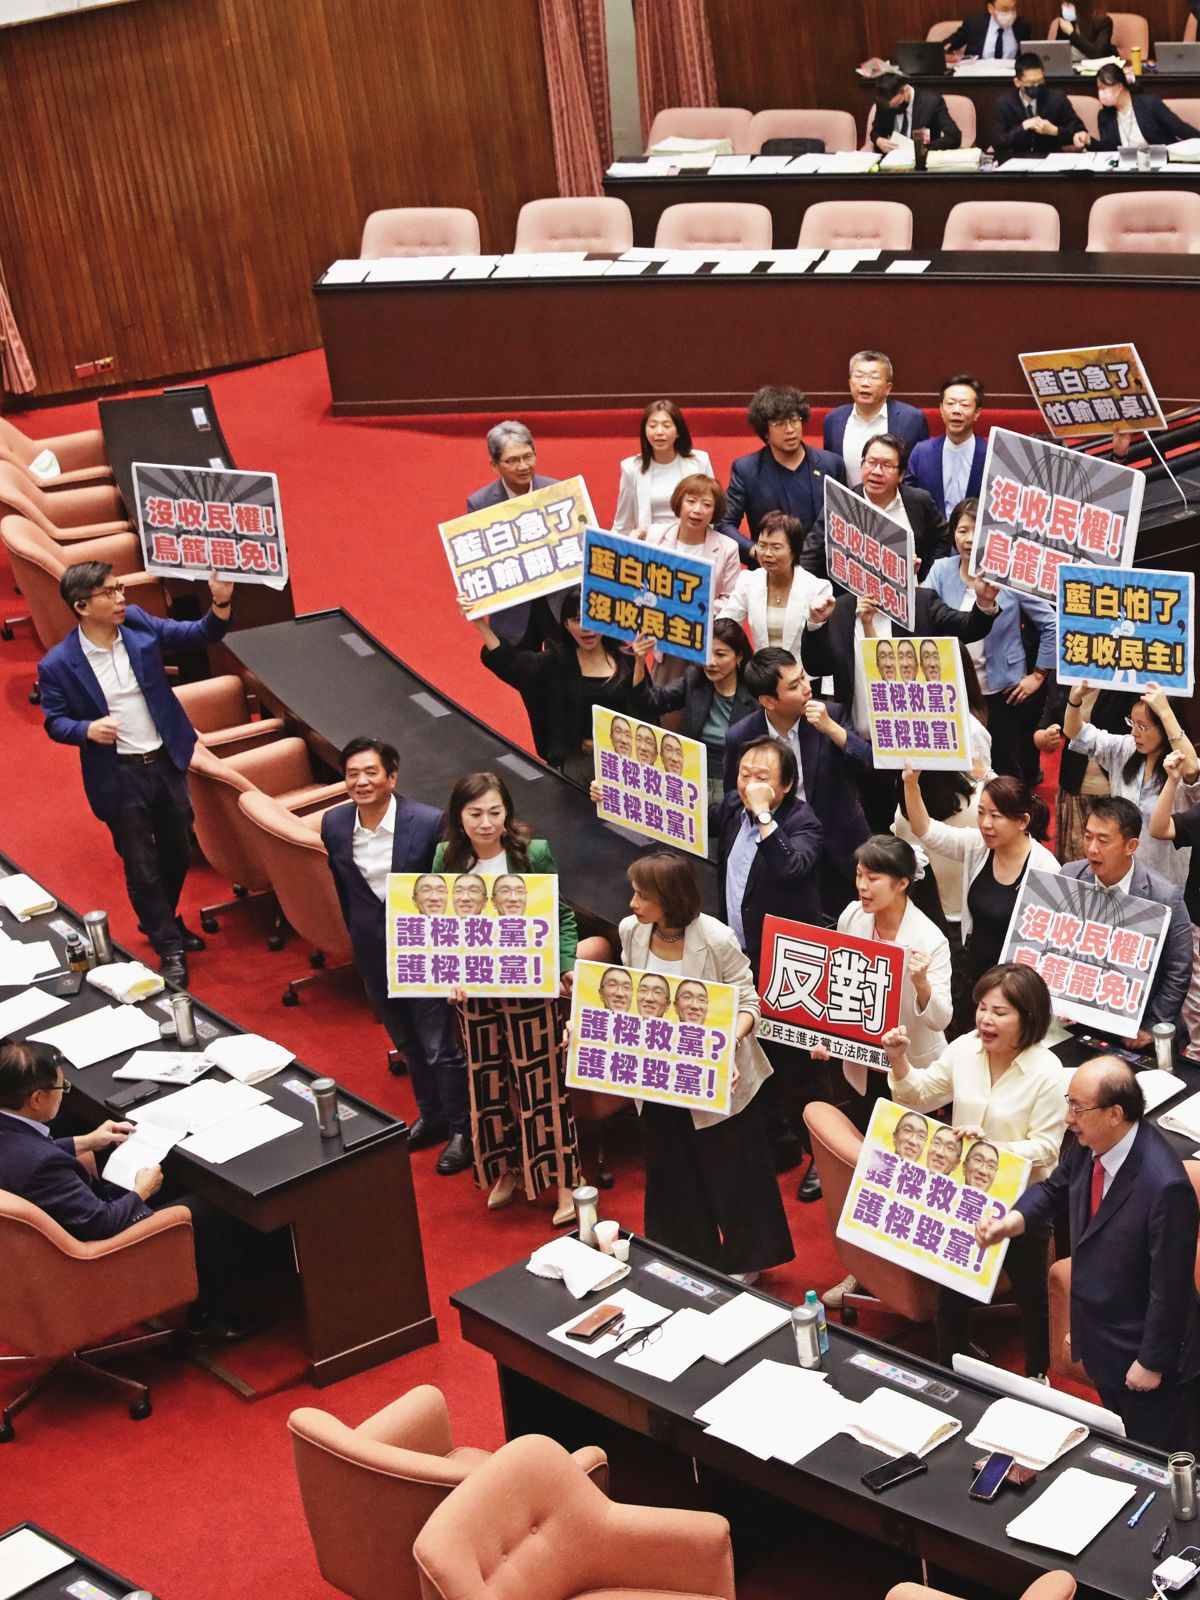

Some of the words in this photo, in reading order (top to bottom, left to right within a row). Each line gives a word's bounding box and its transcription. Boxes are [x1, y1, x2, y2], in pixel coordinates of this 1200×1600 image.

[1031, 362, 1143, 397] 藍白急了,
[1045, 393, 1156, 427] 怕輸翻桌!
[146, 497, 275, 538] 沒收民權!
[990, 476, 1124, 558] 沒收民權!
[151, 532, 280, 571] 鳥籠罷免!
[829, 512, 907, 587] 沒收民權!
[980, 530, 1093, 593] 鳥籠罷
[589, 545, 707, 617] 藍白怕了,
[586, 590, 704, 650] 沒收民主!
[1064, 581, 1186, 636] 藍白怕了,
[1063, 632, 1183, 674] 沒收民主!
[870, 682, 957, 714] 護樑救黨?
[874, 718, 958, 751] 護樑毀黨!
[600, 749, 698, 813] 護樑救黨?
[601, 784, 695, 845] 護樑毀黨!
[396, 916, 549, 948] 護樑救黨?
[1018, 904, 1155, 971] 沒收民權!
[396, 954, 543, 985] 護樑毀黨!
[764, 934, 892, 1035] 反對
[580, 1007, 726, 1060] 護樑救黨?
[576, 1046, 716, 1099] 護樑毀黨!
[853, 1189, 988, 1273] 護樑毀黨!
